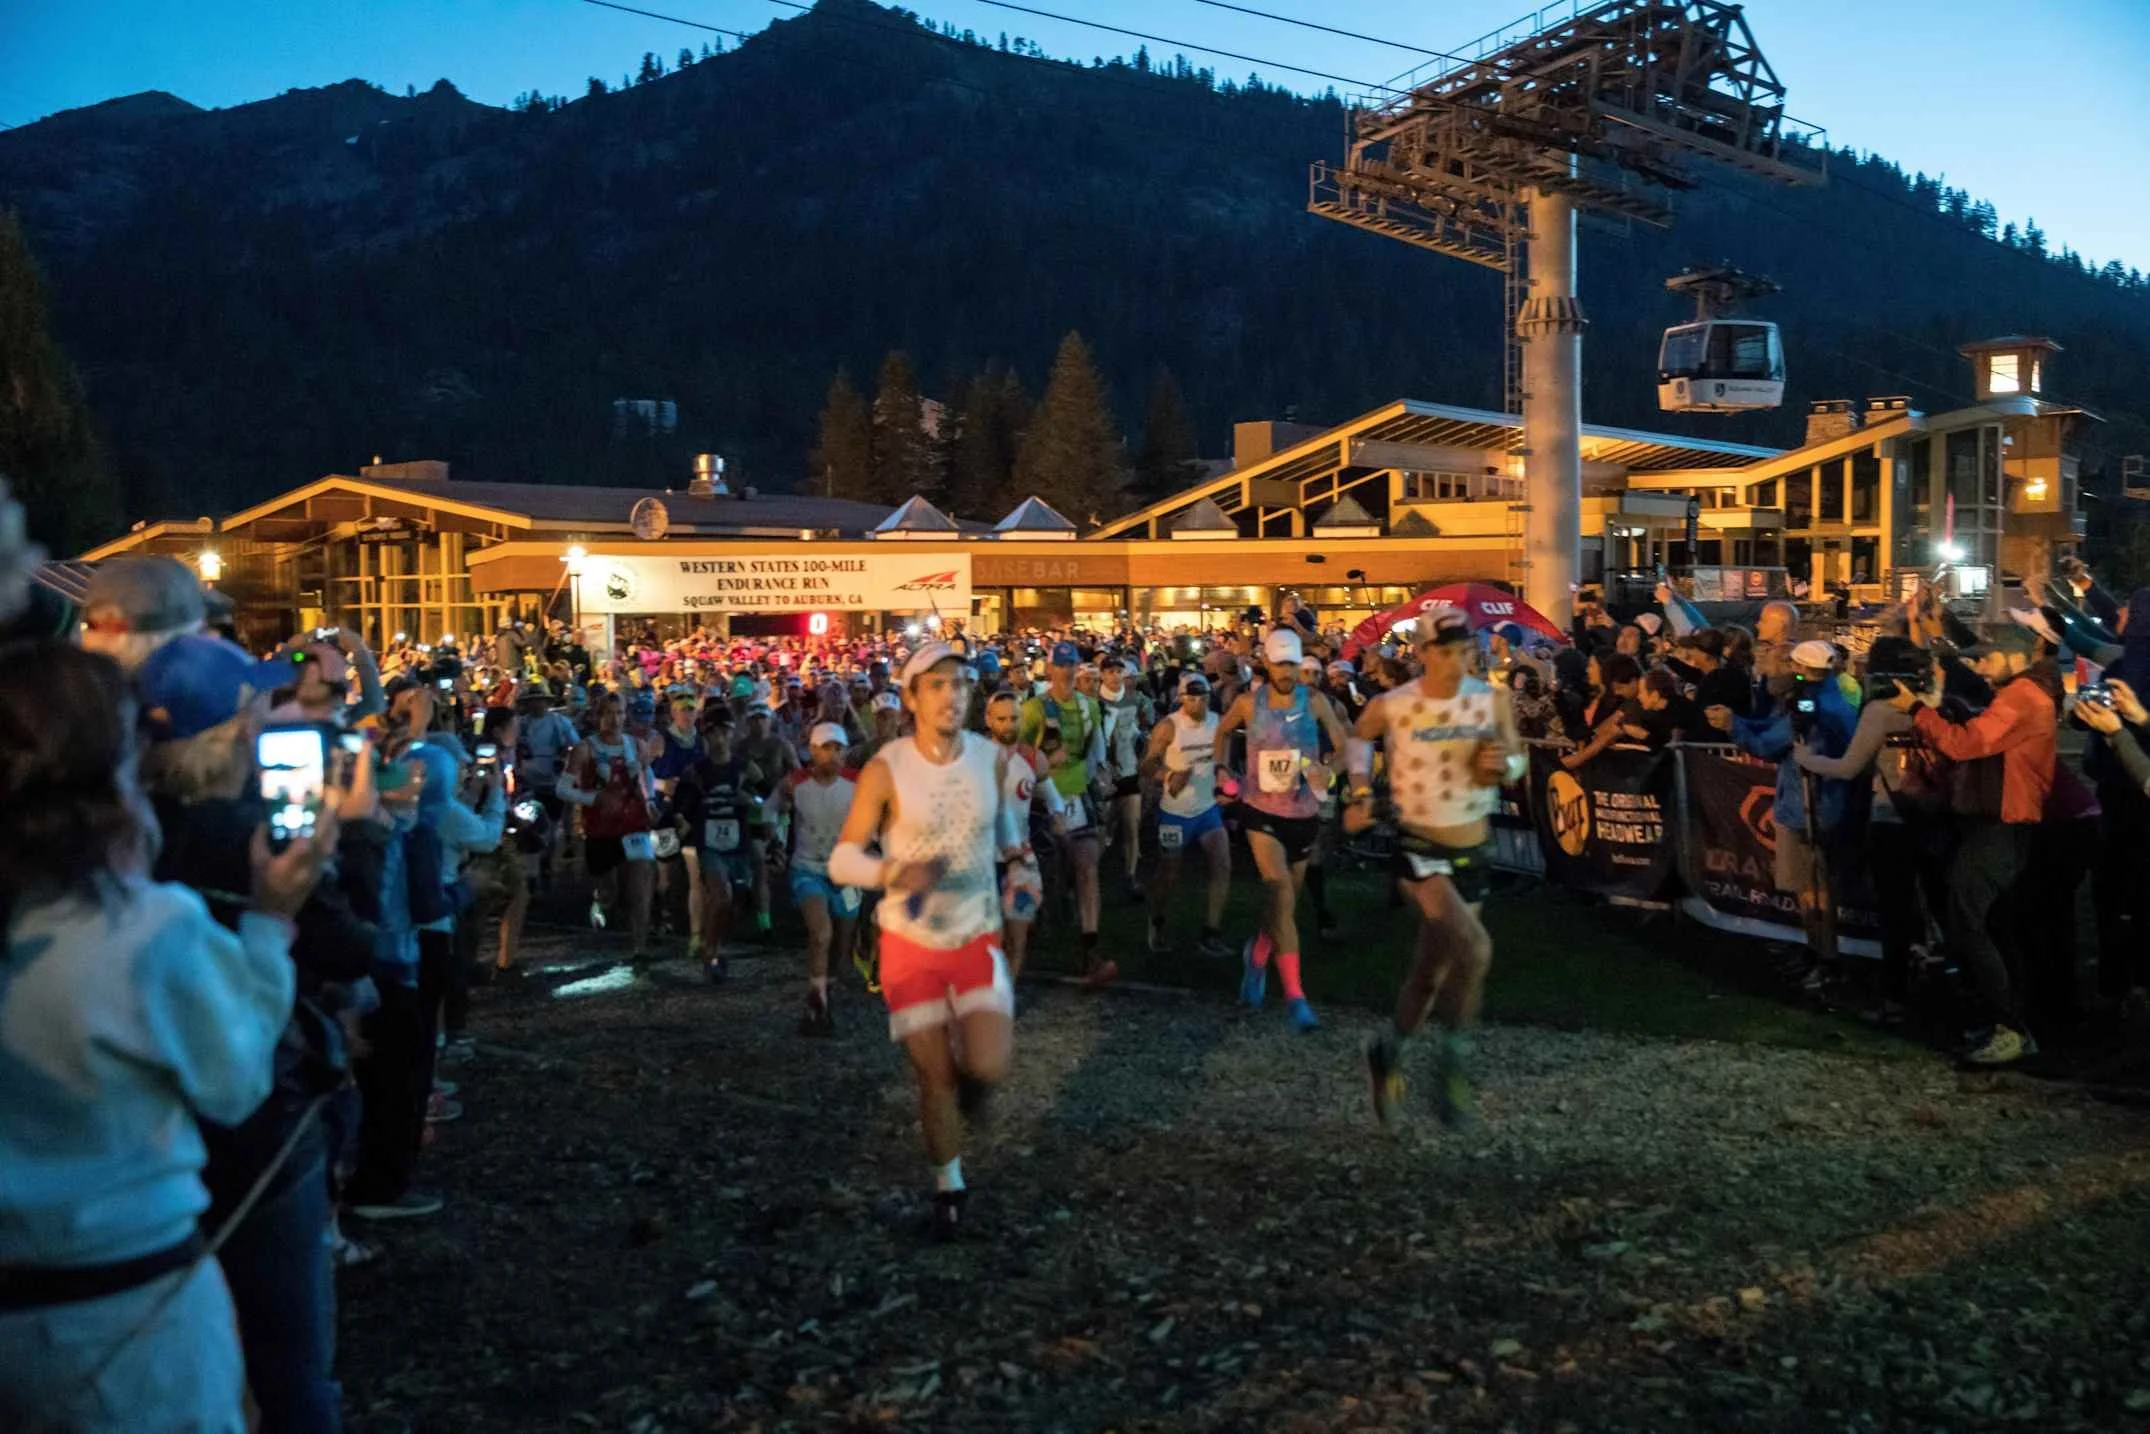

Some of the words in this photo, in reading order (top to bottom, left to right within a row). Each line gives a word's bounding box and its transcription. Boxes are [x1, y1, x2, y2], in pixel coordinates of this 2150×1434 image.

[680, 561, 746, 573] WESTERN
[750, 561, 799, 573] STATES
[803, 560, 867, 572] 100-MILE
[717, 578, 798, 590] ENDURANCE
[802, 578, 830, 589] RUN
[892, 583, 957, 591] ALTRA
[683, 596, 724, 608] SQUAW
[727, 596, 770, 606] VALLEY
[775, 595, 790, 605] TO
[849, 594, 863, 604] CA
[1480, 602, 1514, 615] CLIF
